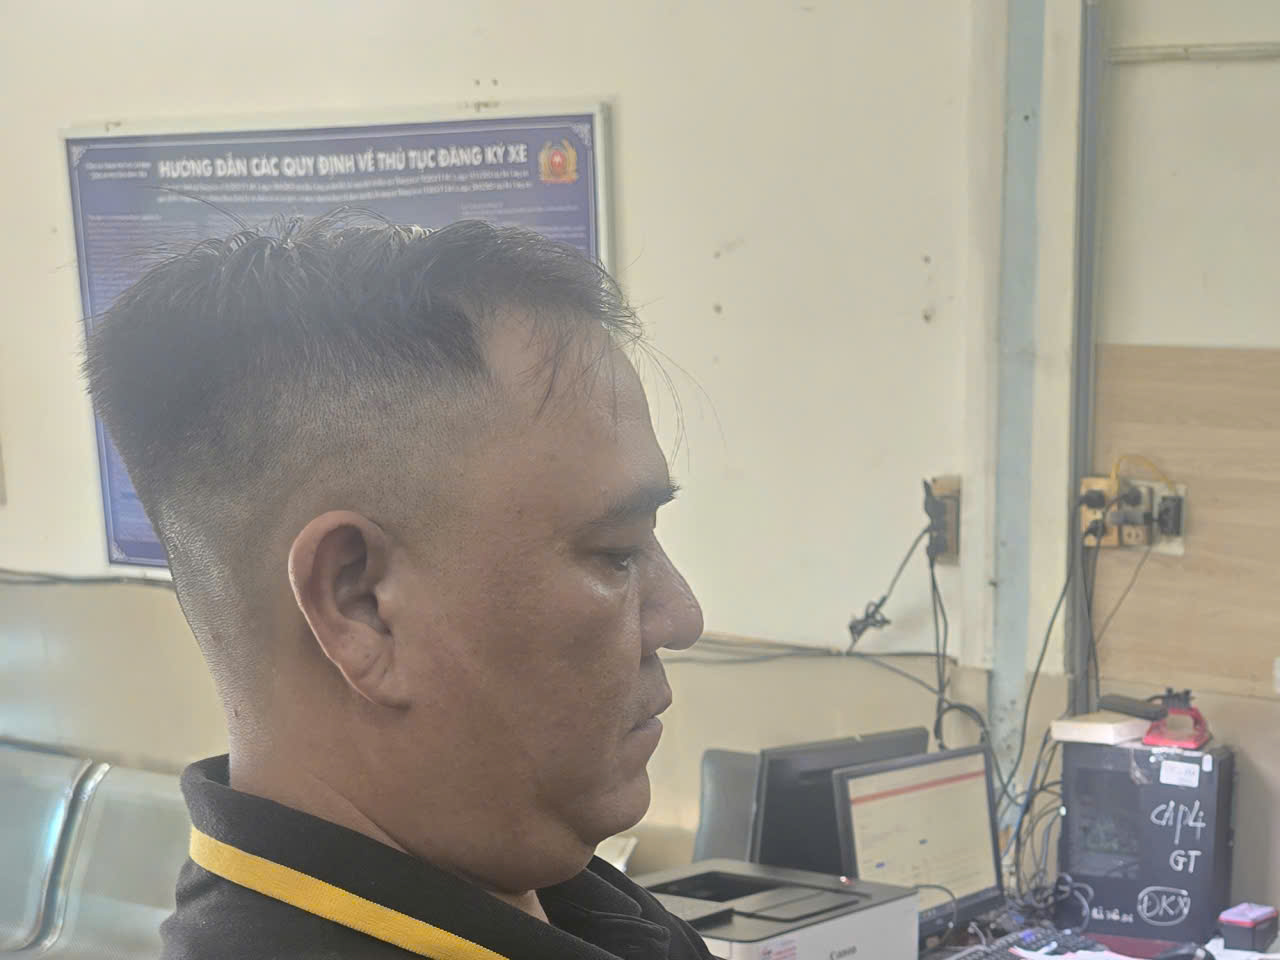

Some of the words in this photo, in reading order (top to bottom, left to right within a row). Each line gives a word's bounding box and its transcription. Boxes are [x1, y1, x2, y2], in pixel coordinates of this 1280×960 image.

[251, 154, 280, 177] CÁC
[282, 156, 315, 176] QUY
[318, 152, 355, 179] ĐỊNH
[408, 149, 436, 173] TỤC
[484, 141, 506, 164] KÝ
[507, 144, 528, 163] XE
[1169, 849, 1202, 873] GT
